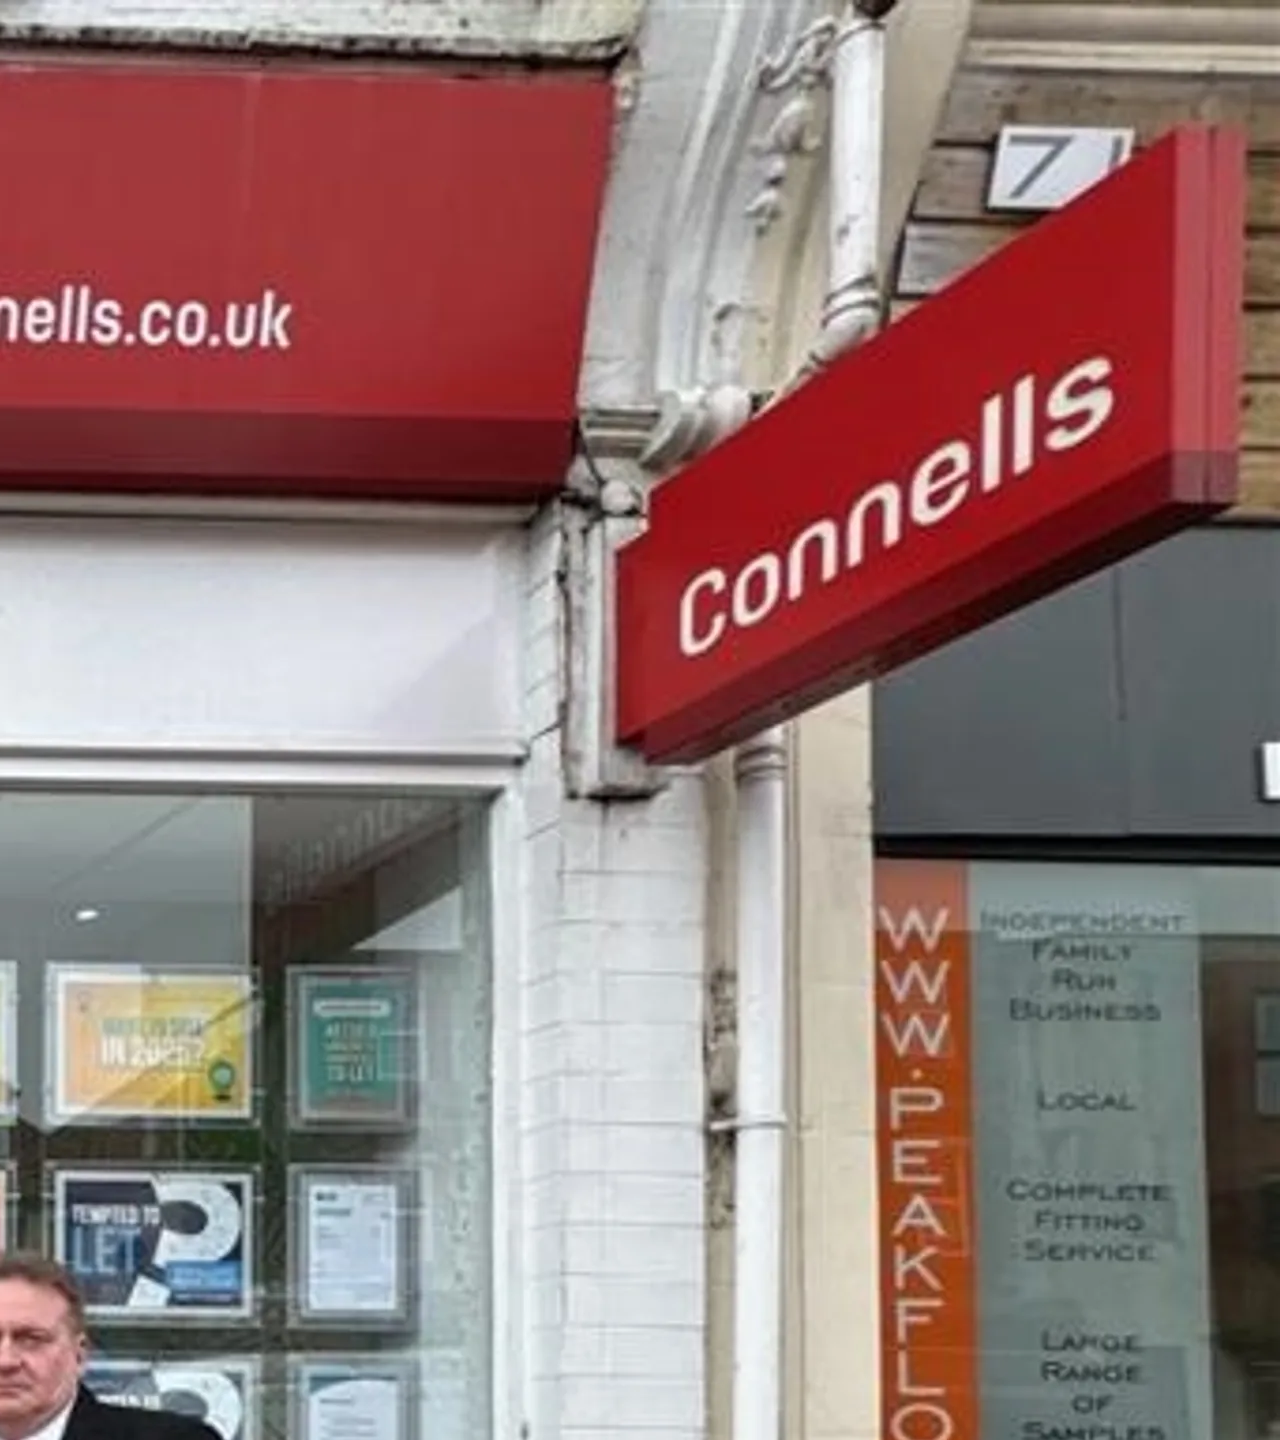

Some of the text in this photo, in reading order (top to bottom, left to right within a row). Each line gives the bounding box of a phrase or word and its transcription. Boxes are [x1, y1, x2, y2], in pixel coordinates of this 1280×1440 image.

[679, 356, 1113, 657] Connells
[1038, 1090, 1137, 1112] LOCAL
[1006, 1180, 1171, 1202] COMPLETE
[1035, 1211, 1146, 1232] FITTING
[1025, 1240, 1156, 1262] SERVICE
[1042, 1361, 1145, 1383] RANGE
[1073, 1394, 1114, 1414] OF
